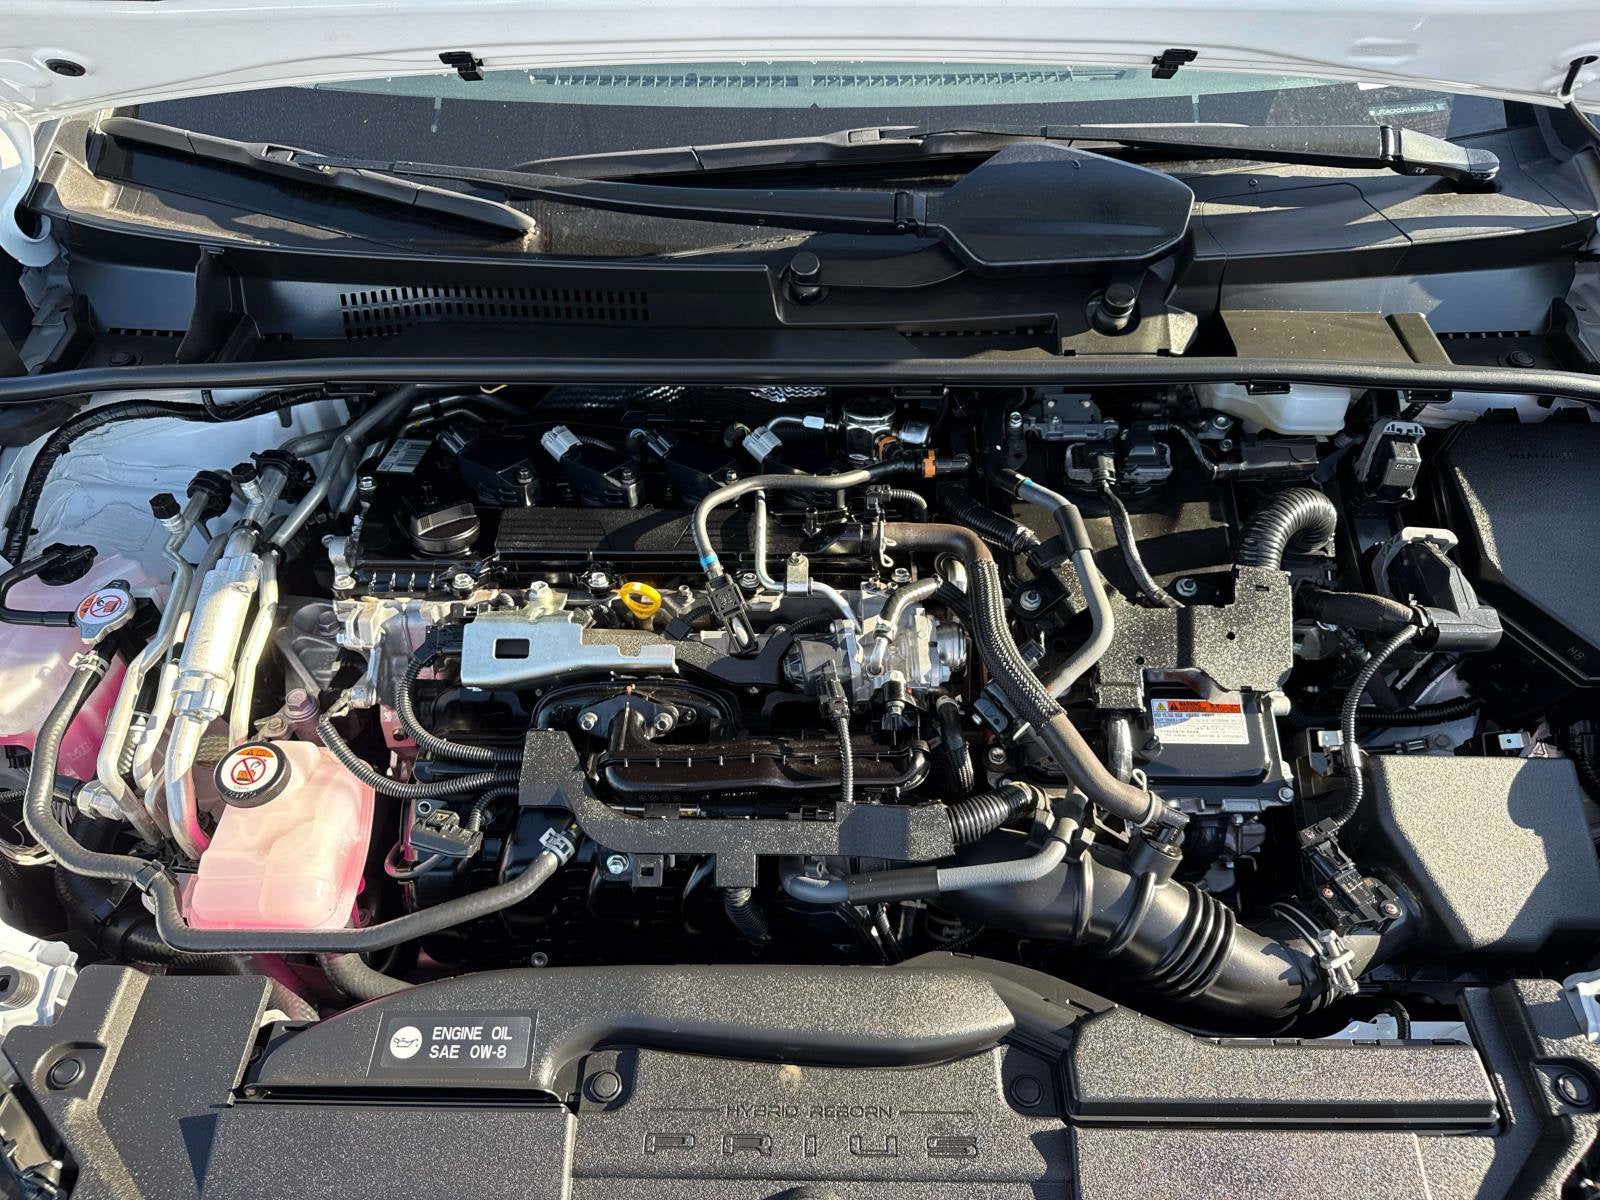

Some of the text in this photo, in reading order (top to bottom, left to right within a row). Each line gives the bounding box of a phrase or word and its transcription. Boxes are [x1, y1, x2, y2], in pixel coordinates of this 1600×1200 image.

[432, 1026, 513, 1041] ENGINE OIL
[429, 1044, 507, 1059] SAE 0W-8
[725, 1105, 893, 1120] HYBRID REBORN
[643, 1132, 978, 1159] PRIUS
